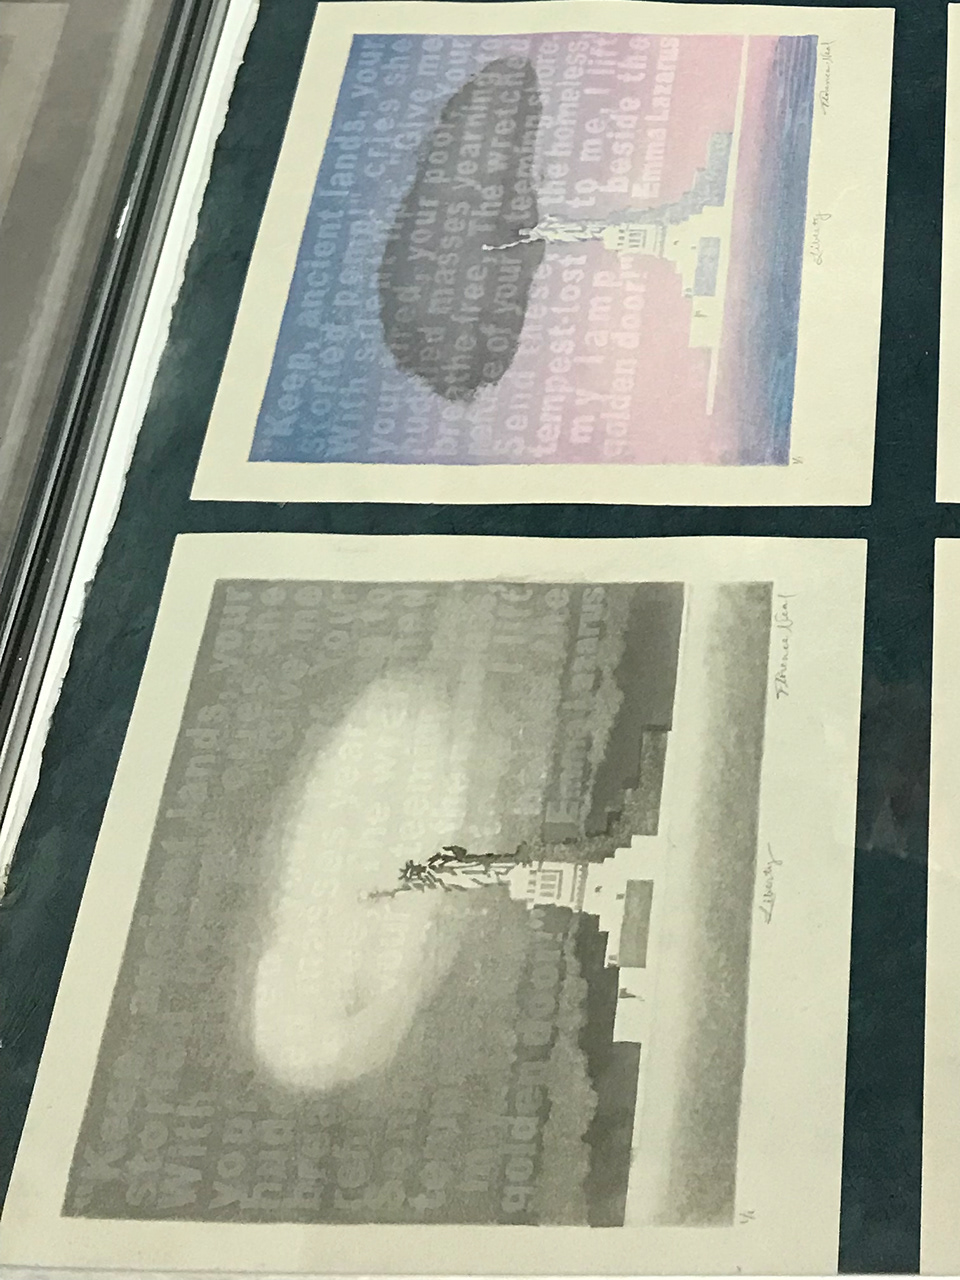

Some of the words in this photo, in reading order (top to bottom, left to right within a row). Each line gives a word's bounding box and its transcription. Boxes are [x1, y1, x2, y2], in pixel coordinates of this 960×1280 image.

[585, 37, 619, 75] lift
[615, 36, 651, 82] the
[644, 37, 678, 121] Lazarus
[486, 39, 530, 173] wretched
[544, 34, 596, 157] homeless,
[600, 97, 641, 192] beside
[630, 128, 667, 198] Emma
[428, 201, 471, 314] masses
[451, 72, 498, 190] yearning
[466, 184, 504, 237] The
[450, 256, 498, 324] free,
